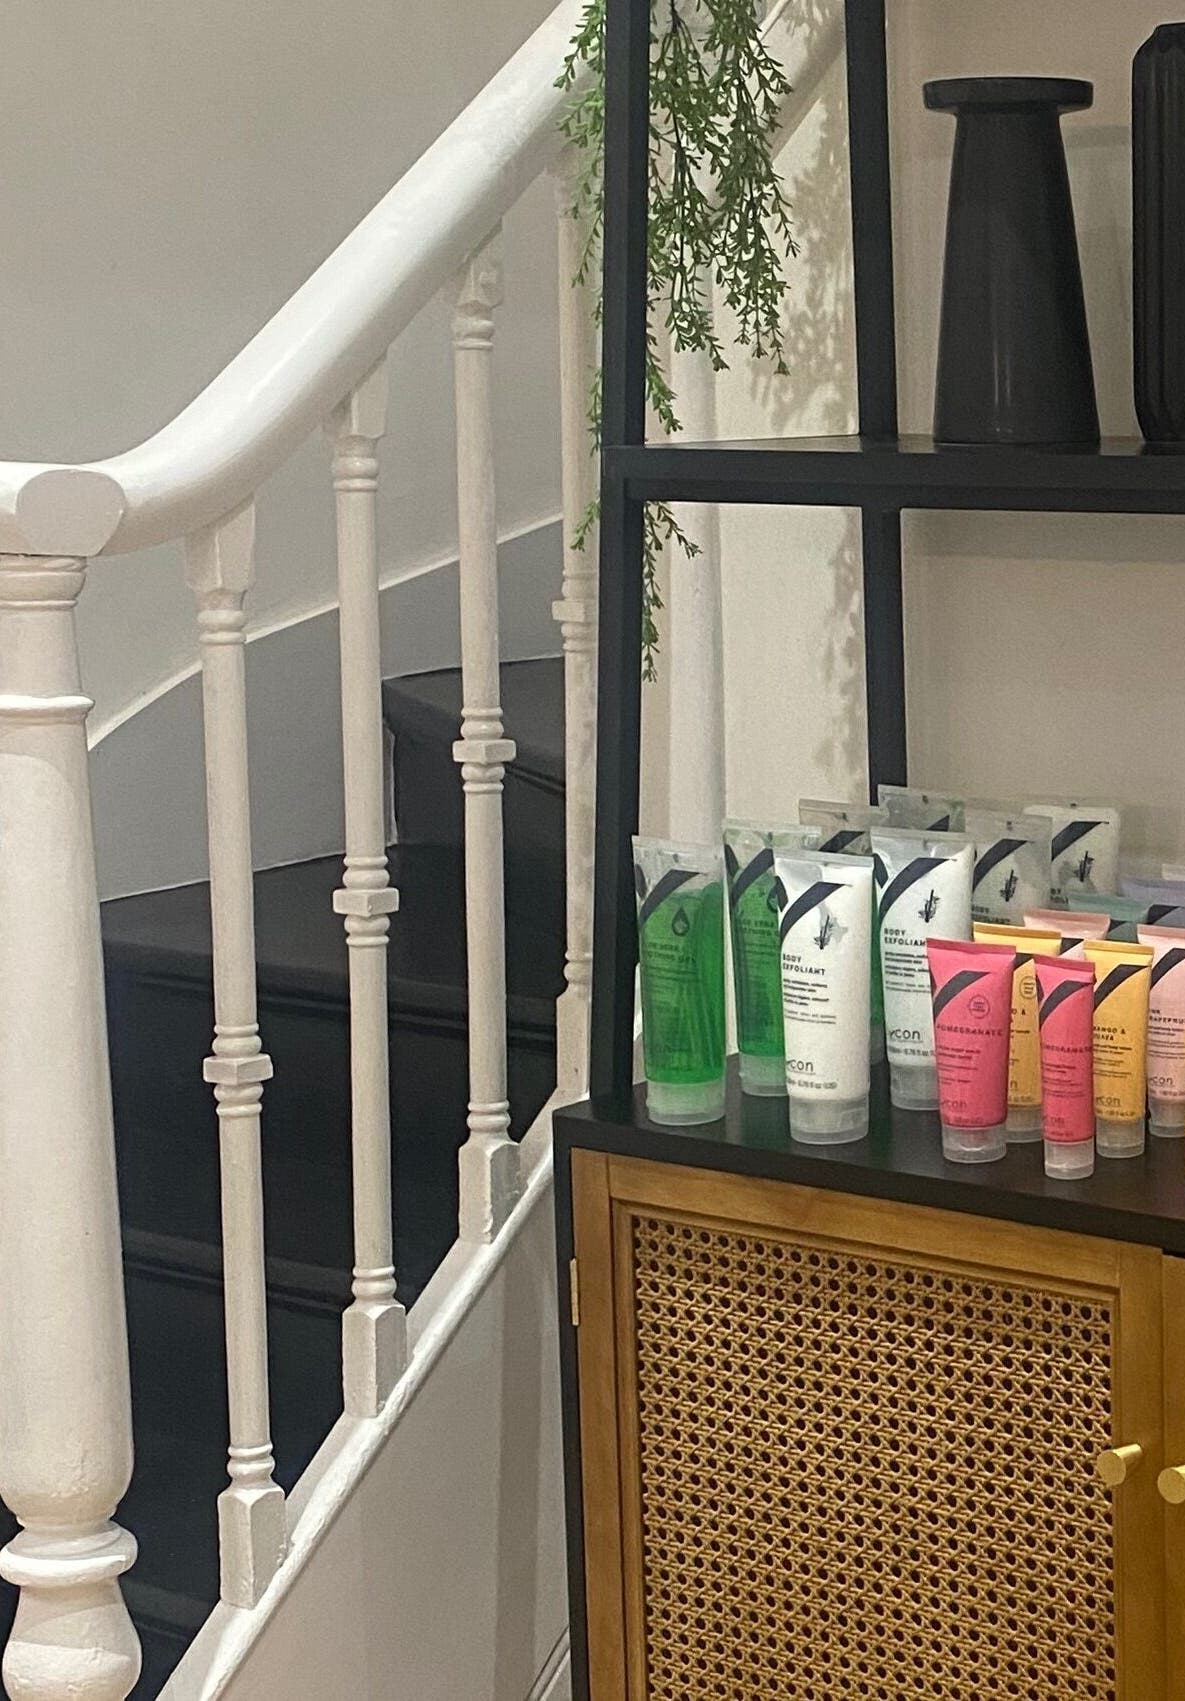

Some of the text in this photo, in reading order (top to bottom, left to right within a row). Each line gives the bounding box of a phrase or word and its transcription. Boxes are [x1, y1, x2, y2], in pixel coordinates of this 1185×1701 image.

[884, 927, 906, 936] BODY
[884, 937, 926, 946] EXFOLIAN
[782, 953, 802, 963] BODY
[782, 962, 826, 976] EXFOLIANT
